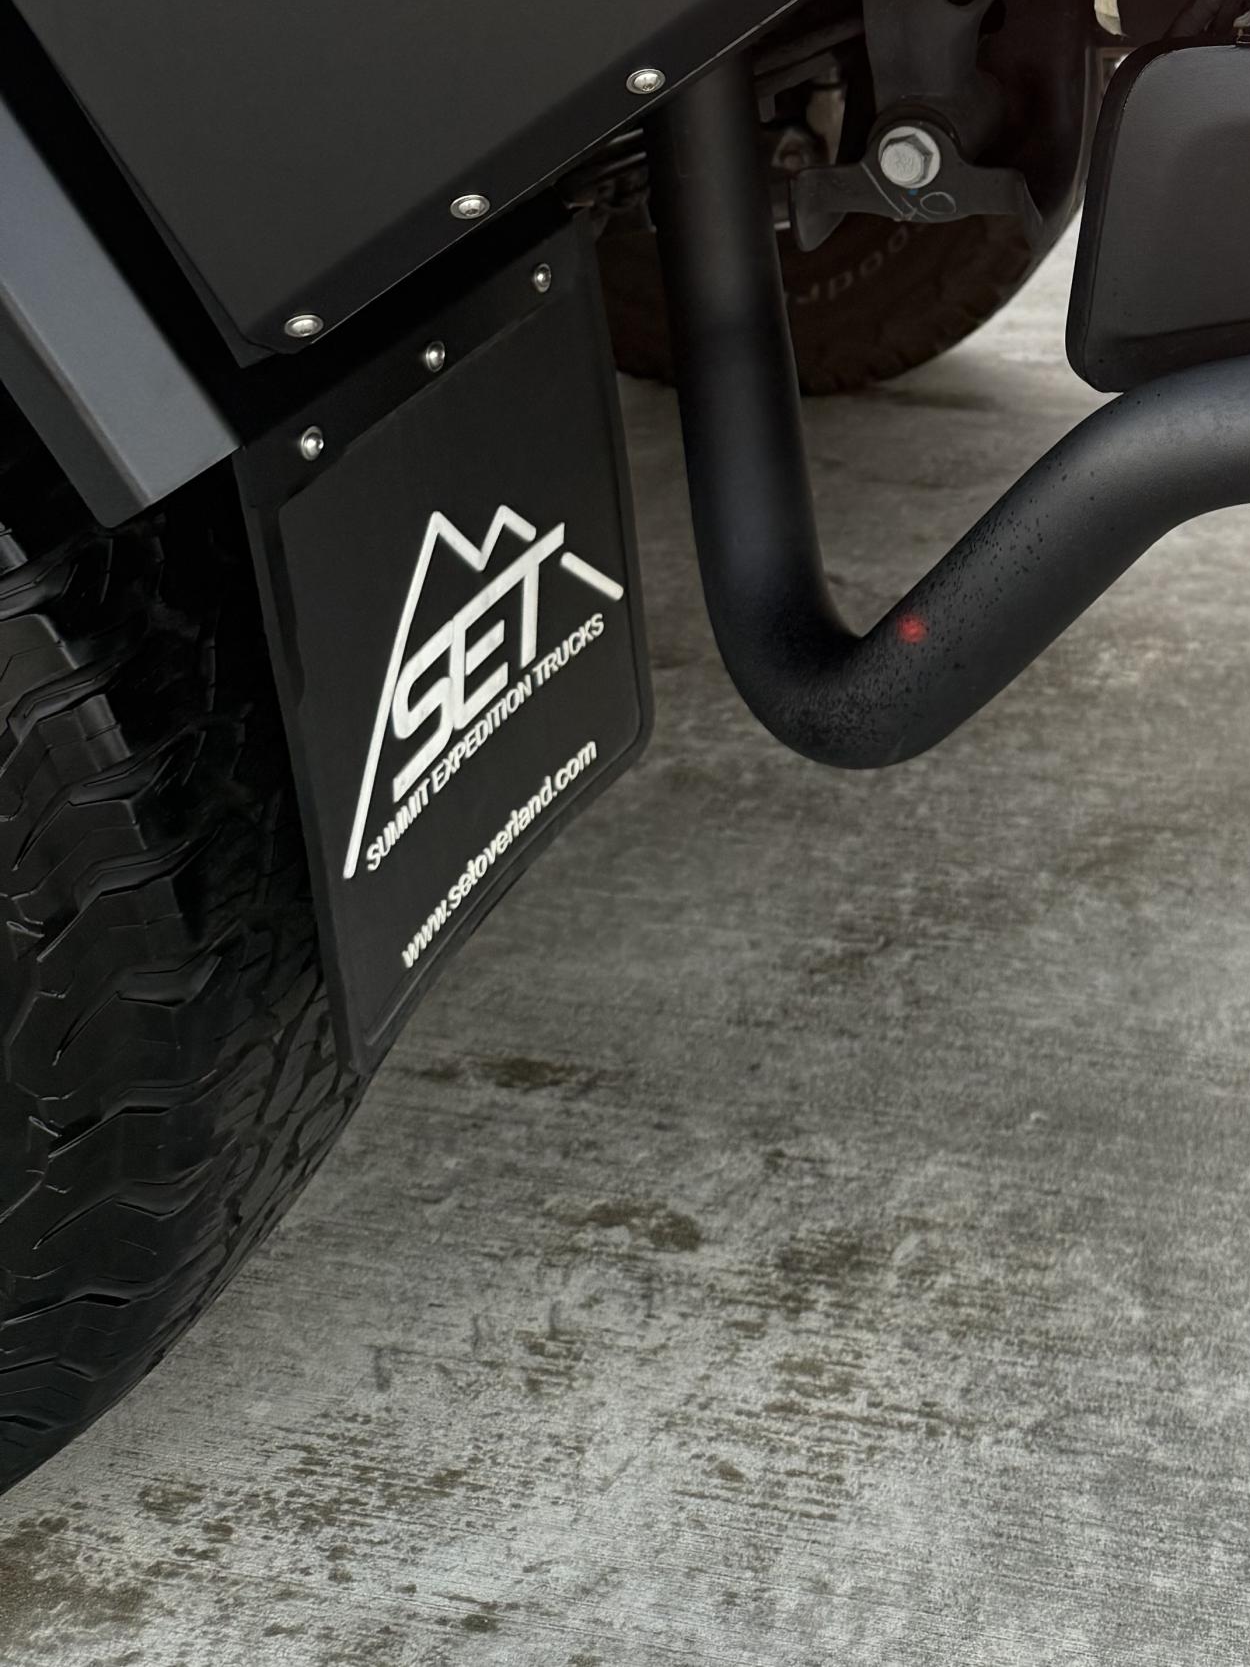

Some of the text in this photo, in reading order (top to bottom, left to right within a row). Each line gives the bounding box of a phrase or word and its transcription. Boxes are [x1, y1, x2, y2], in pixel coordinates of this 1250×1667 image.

[366, 612, 605, 871] SUMMIT EXPEDITION TRUCKS
[393, 522, 565, 803] SET
[401, 740, 598, 969] www.setoverland.com
